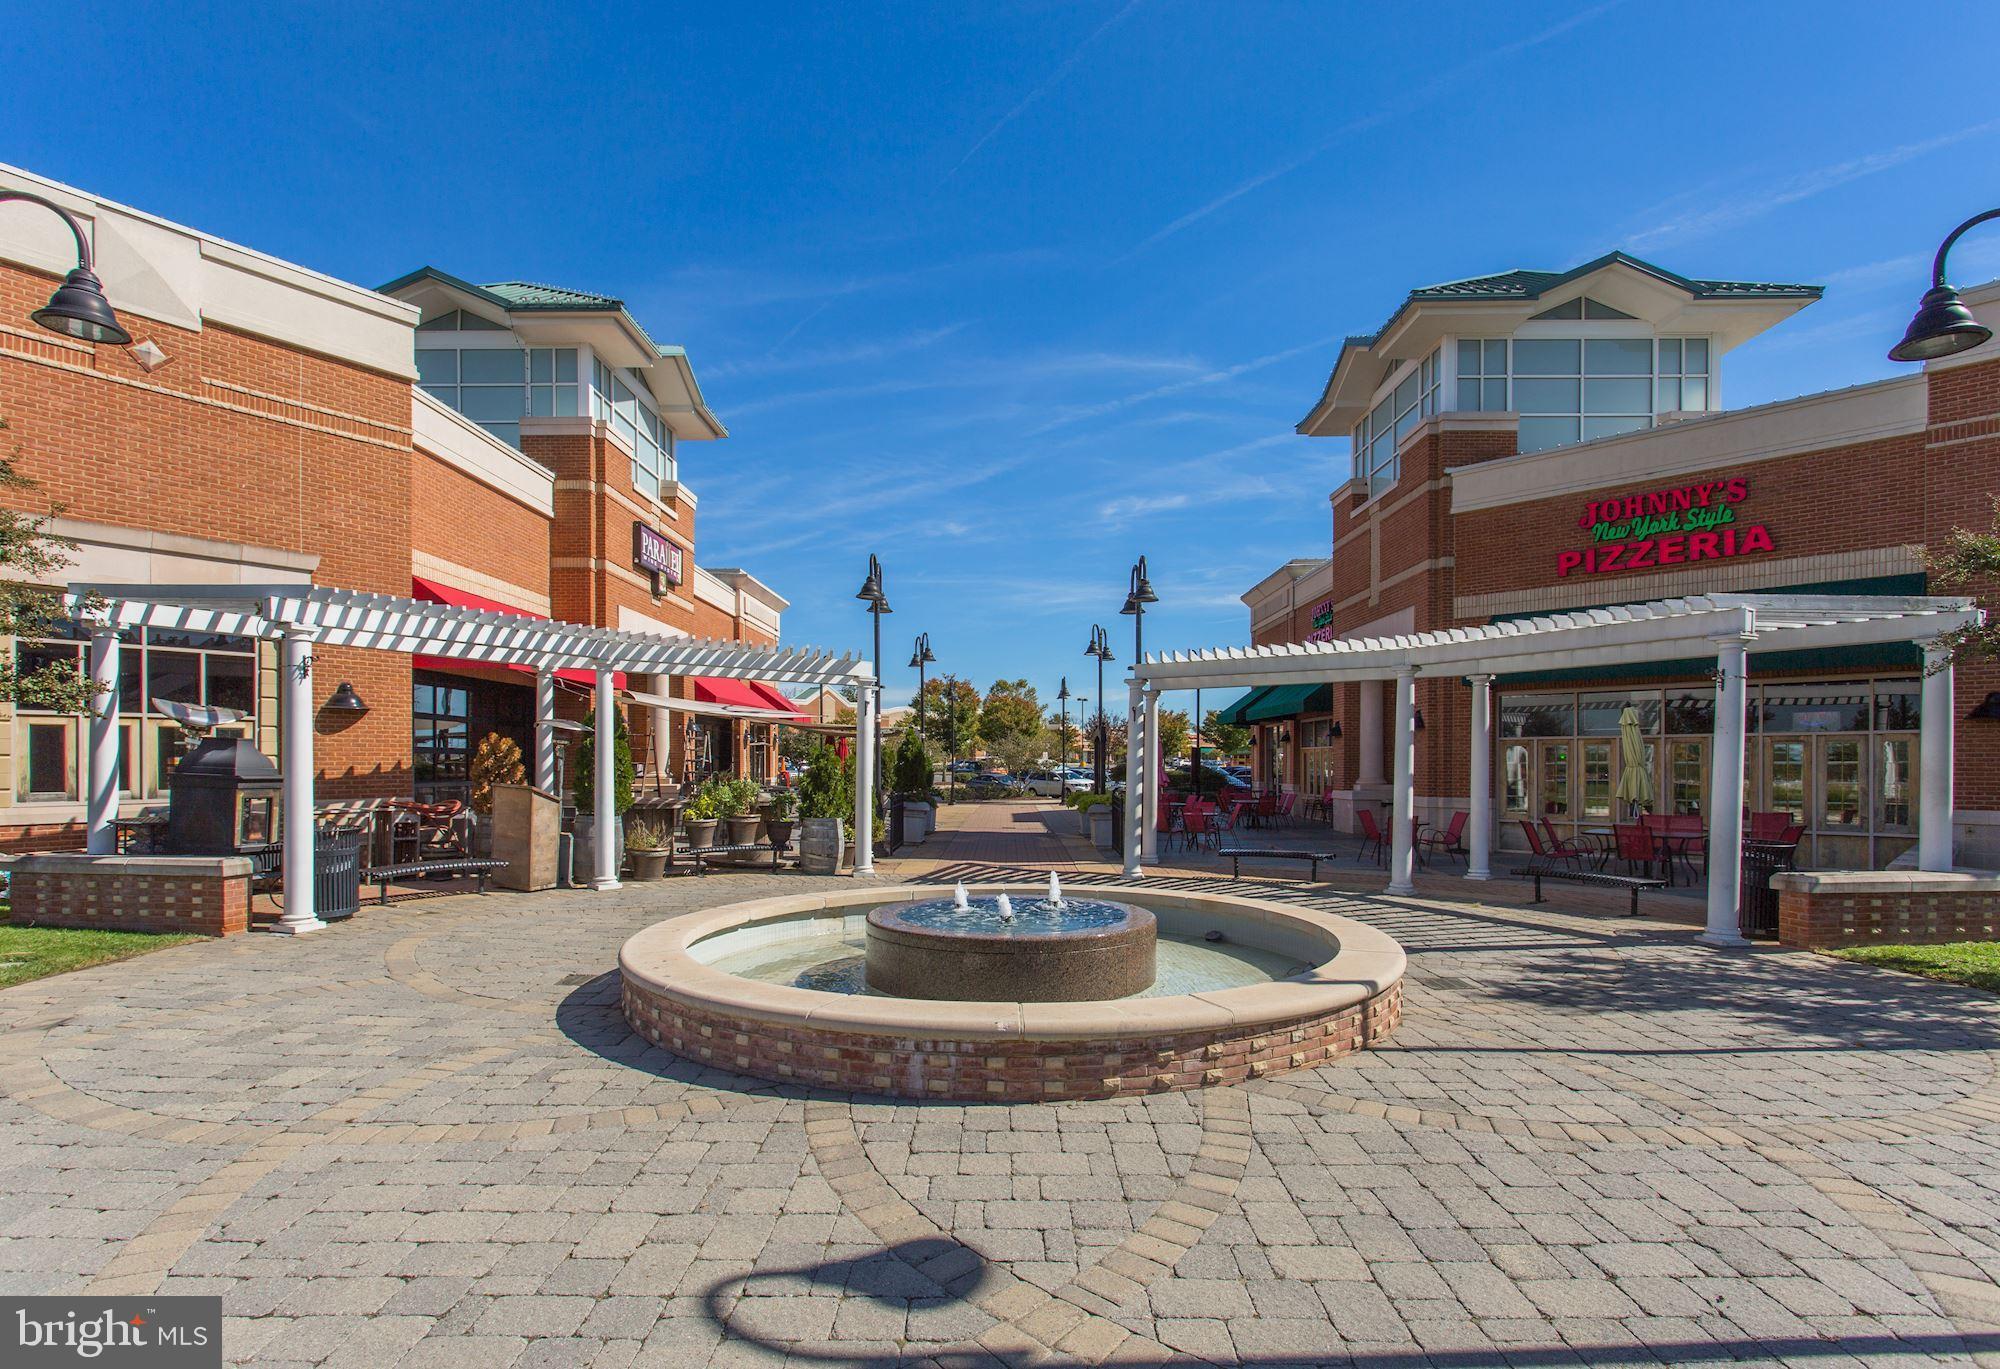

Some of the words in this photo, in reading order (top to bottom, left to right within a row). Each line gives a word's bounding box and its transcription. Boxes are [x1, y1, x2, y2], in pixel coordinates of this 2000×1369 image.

[1579, 477, 1748, 529] JOHNNY'S
[1591, 521, 1631, 542] New
[1631, 511, 1681, 541] York
[1683, 503, 1736, 531] Style
[1557, 524, 1775, 577] PIZZERIA
